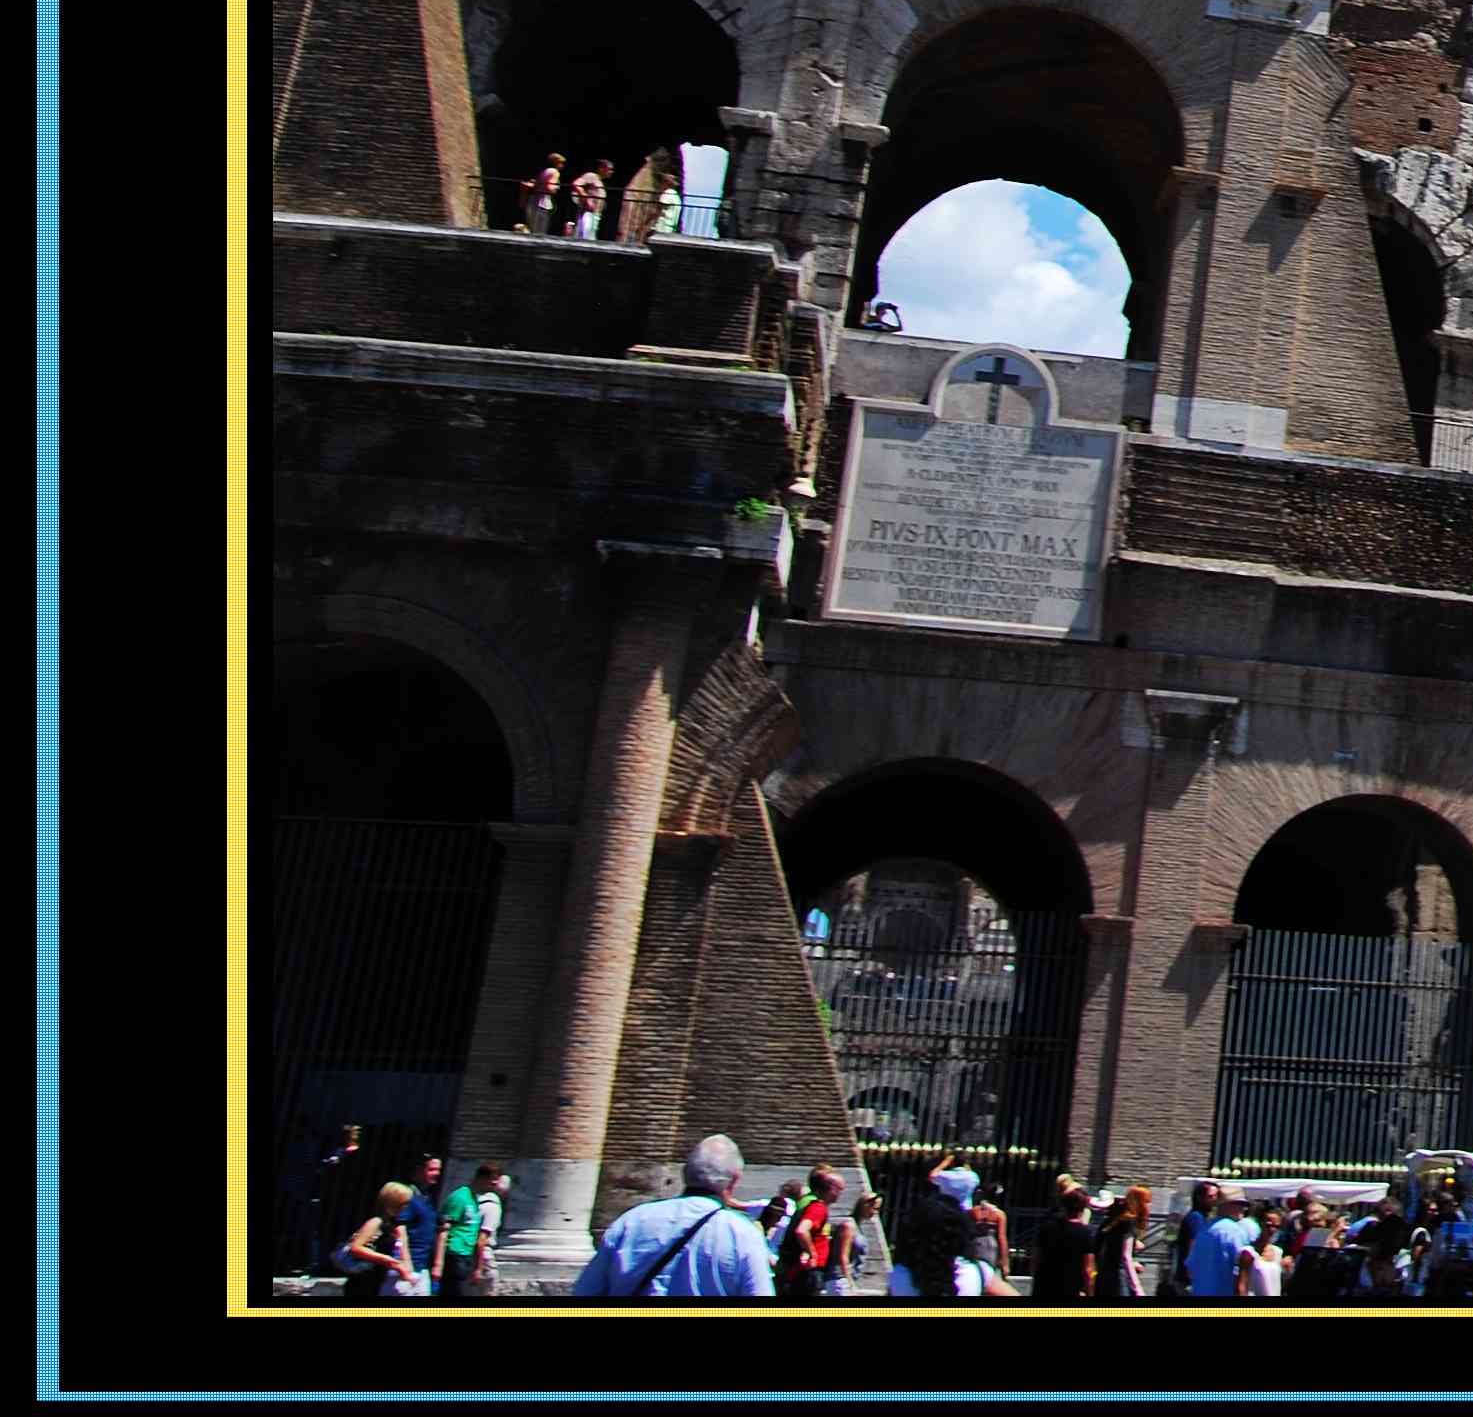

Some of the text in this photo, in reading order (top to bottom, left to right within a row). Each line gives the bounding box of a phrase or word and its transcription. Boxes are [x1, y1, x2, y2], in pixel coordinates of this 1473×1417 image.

[870, 518, 919, 543] PIVS
[954, 526, 1016, 552] PONT
[1021, 533, 1079, 558] MAX
